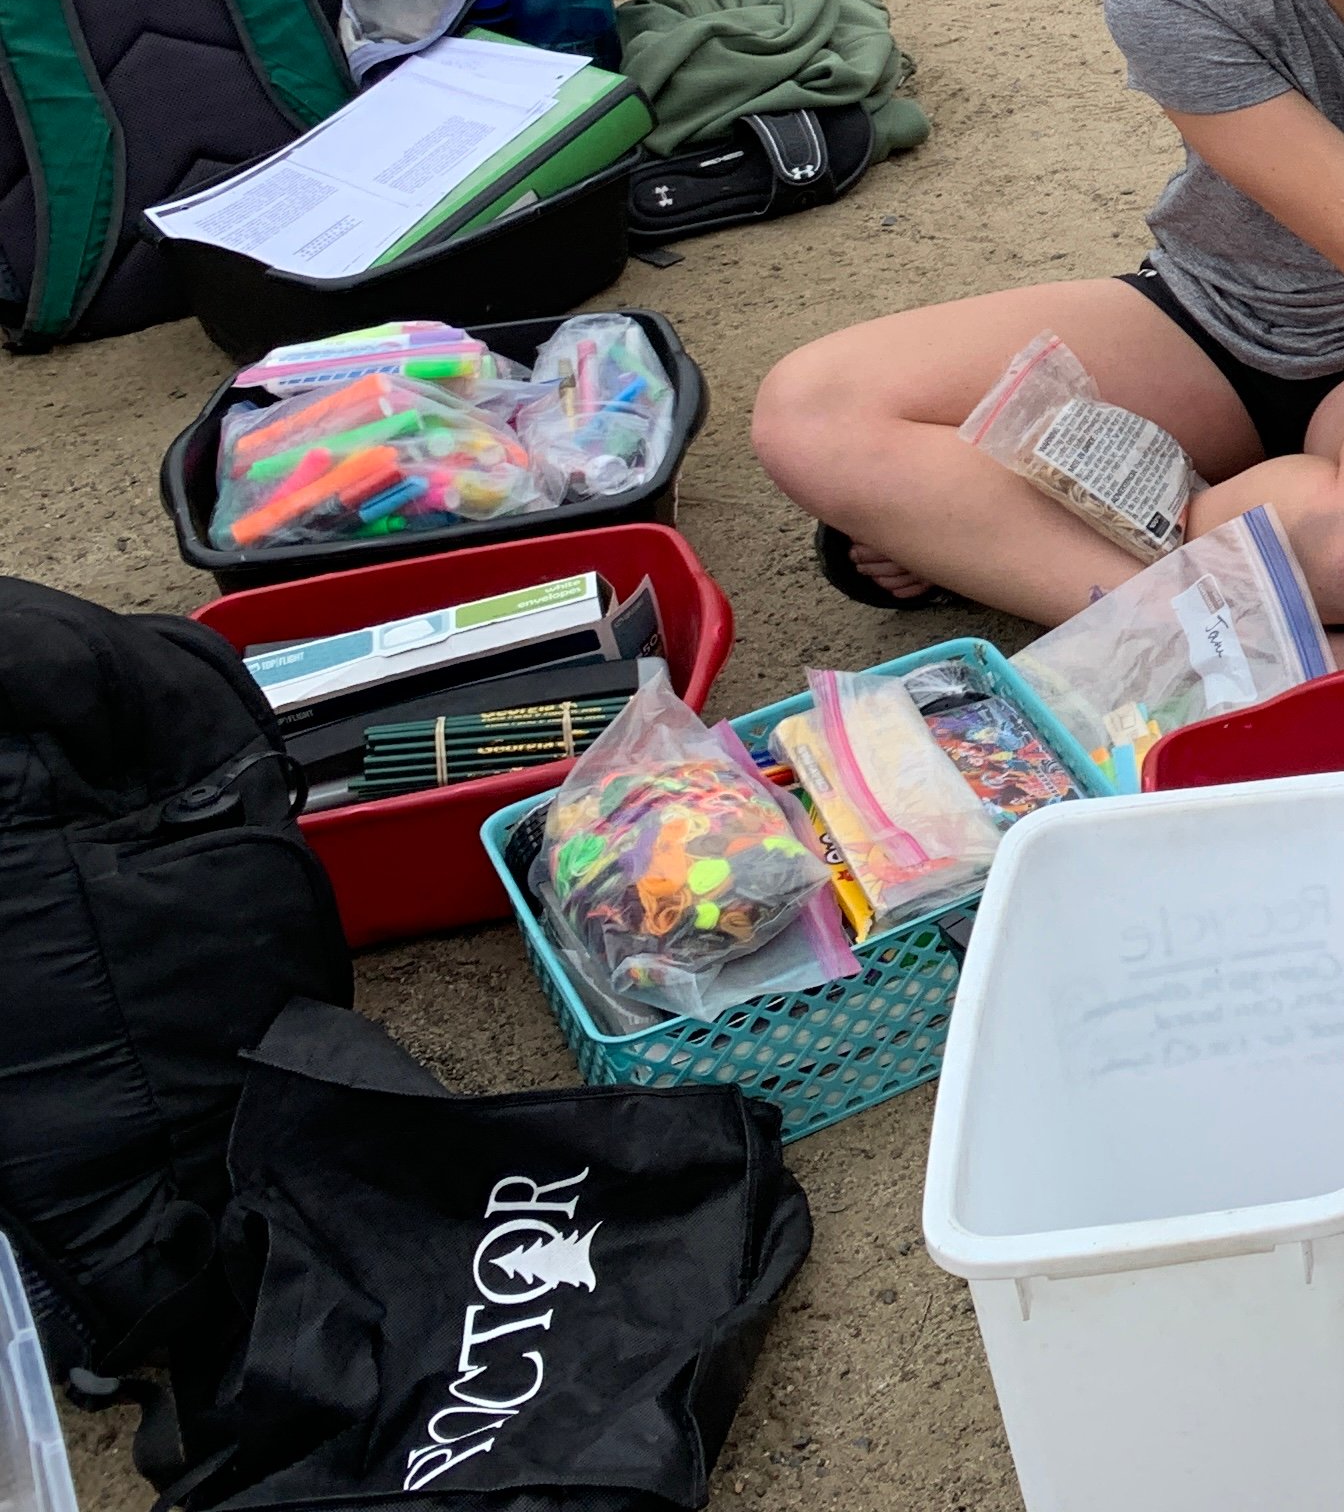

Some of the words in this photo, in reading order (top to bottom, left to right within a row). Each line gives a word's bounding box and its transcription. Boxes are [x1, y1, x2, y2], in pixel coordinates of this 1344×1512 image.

[544, 579, 581, 594] white
[517, 589, 581, 609] envelopes
[477, 741, 556, 755] Georgia
